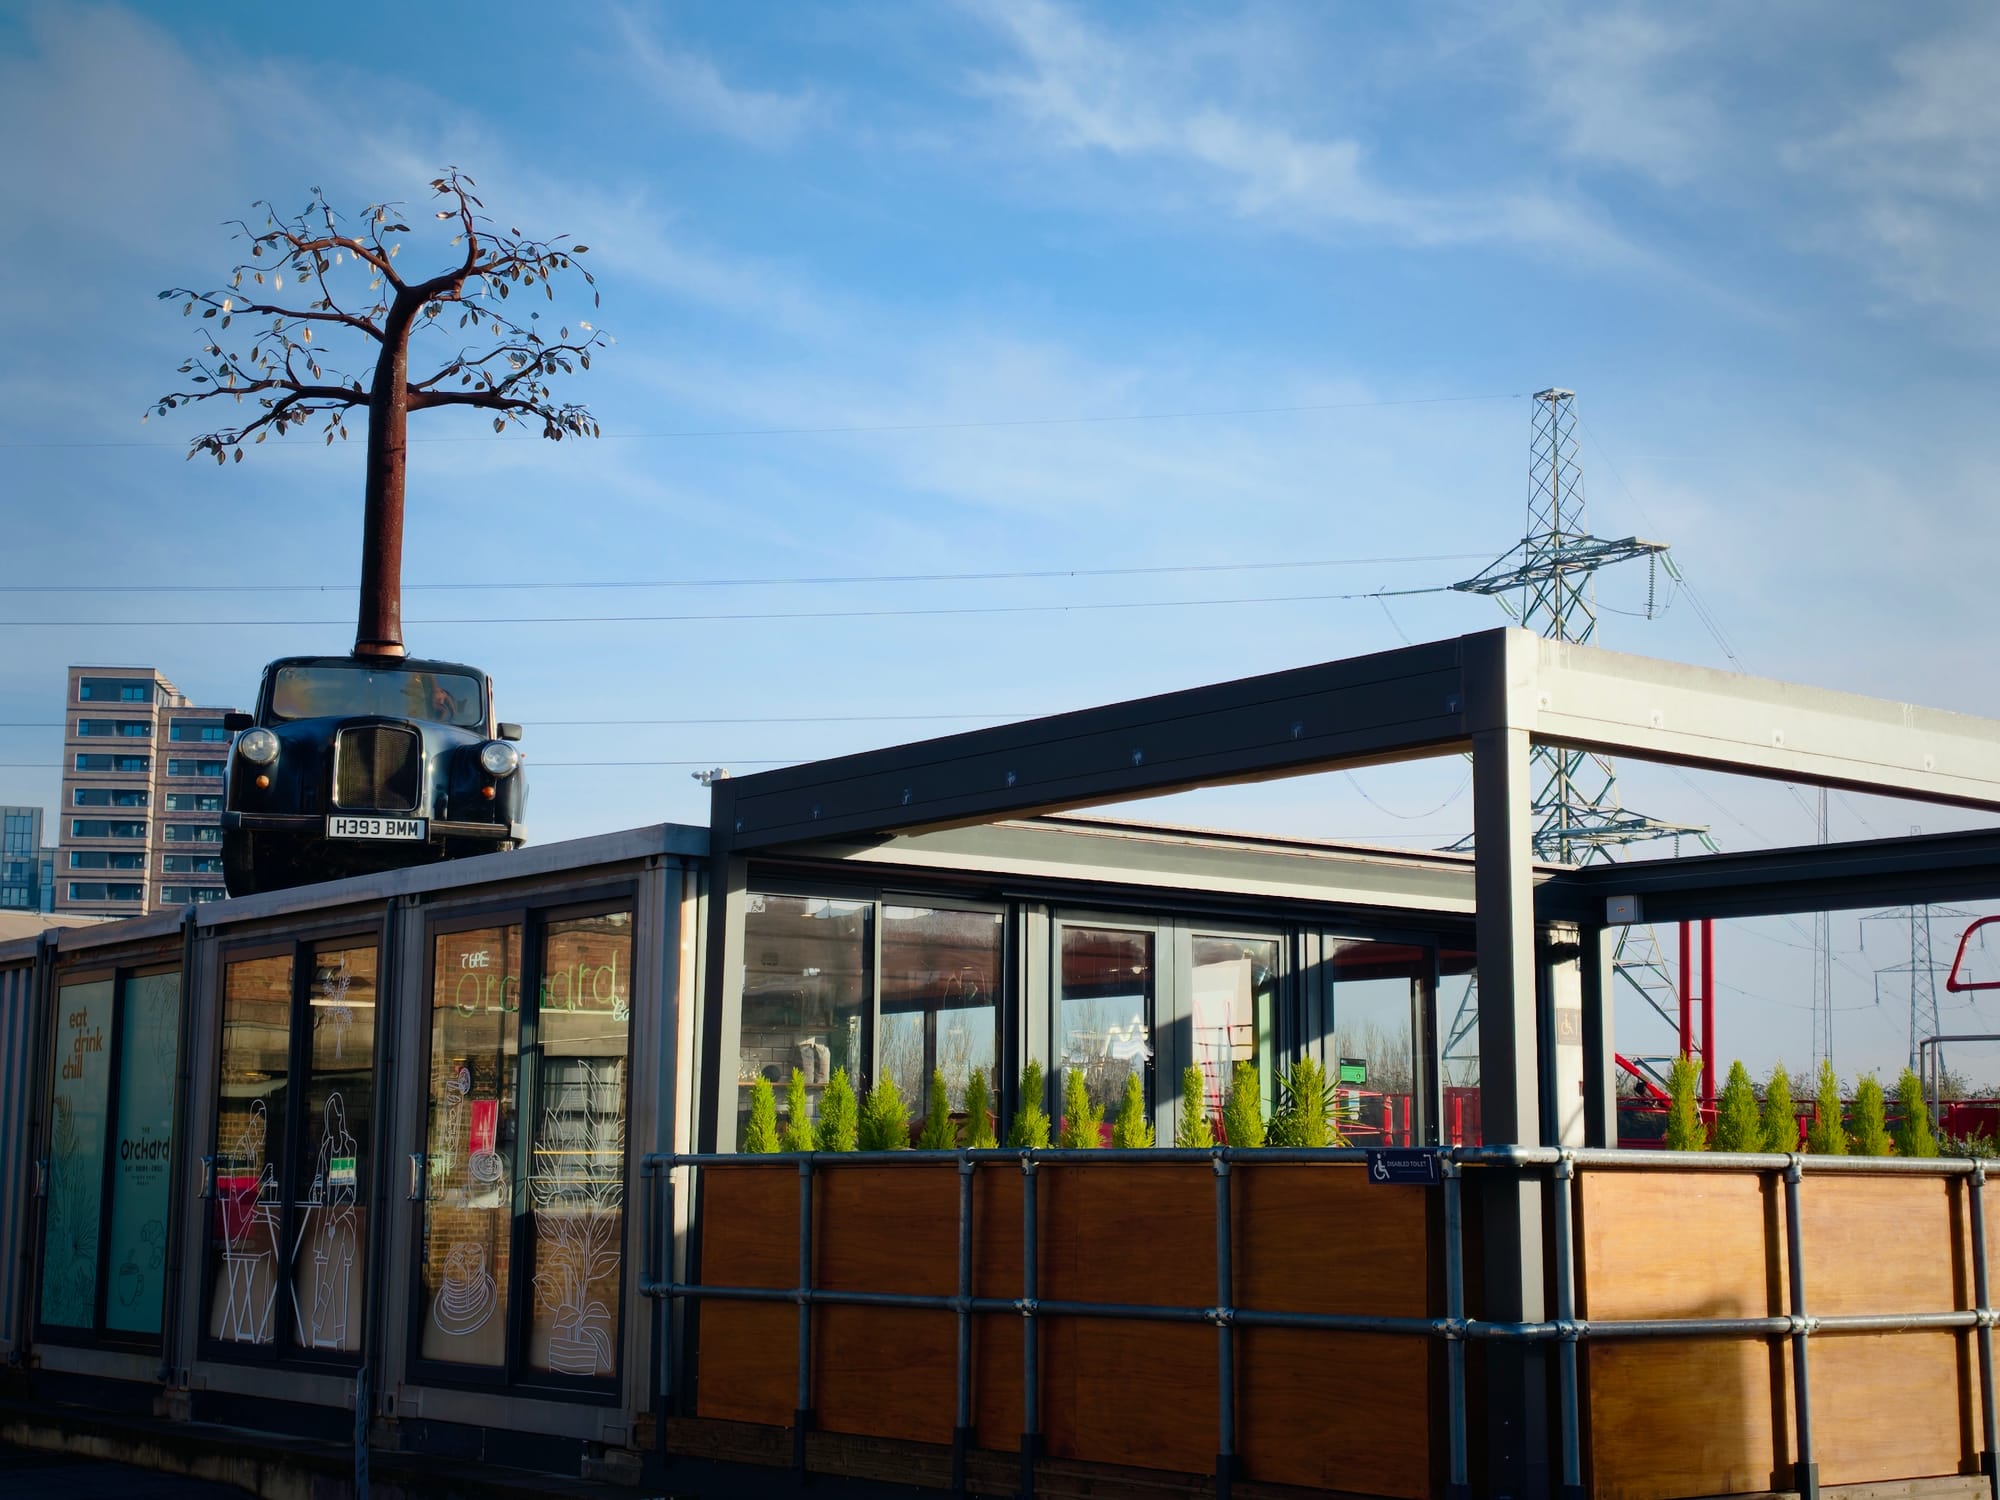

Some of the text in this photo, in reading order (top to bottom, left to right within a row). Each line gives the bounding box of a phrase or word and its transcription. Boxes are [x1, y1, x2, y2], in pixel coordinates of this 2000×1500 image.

[336, 819, 418, 837] H393 BMM
[69, 1005, 87, 1028] eat
[74, 1025, 103, 1053] drink
[62, 1053, 83, 1080] chill
